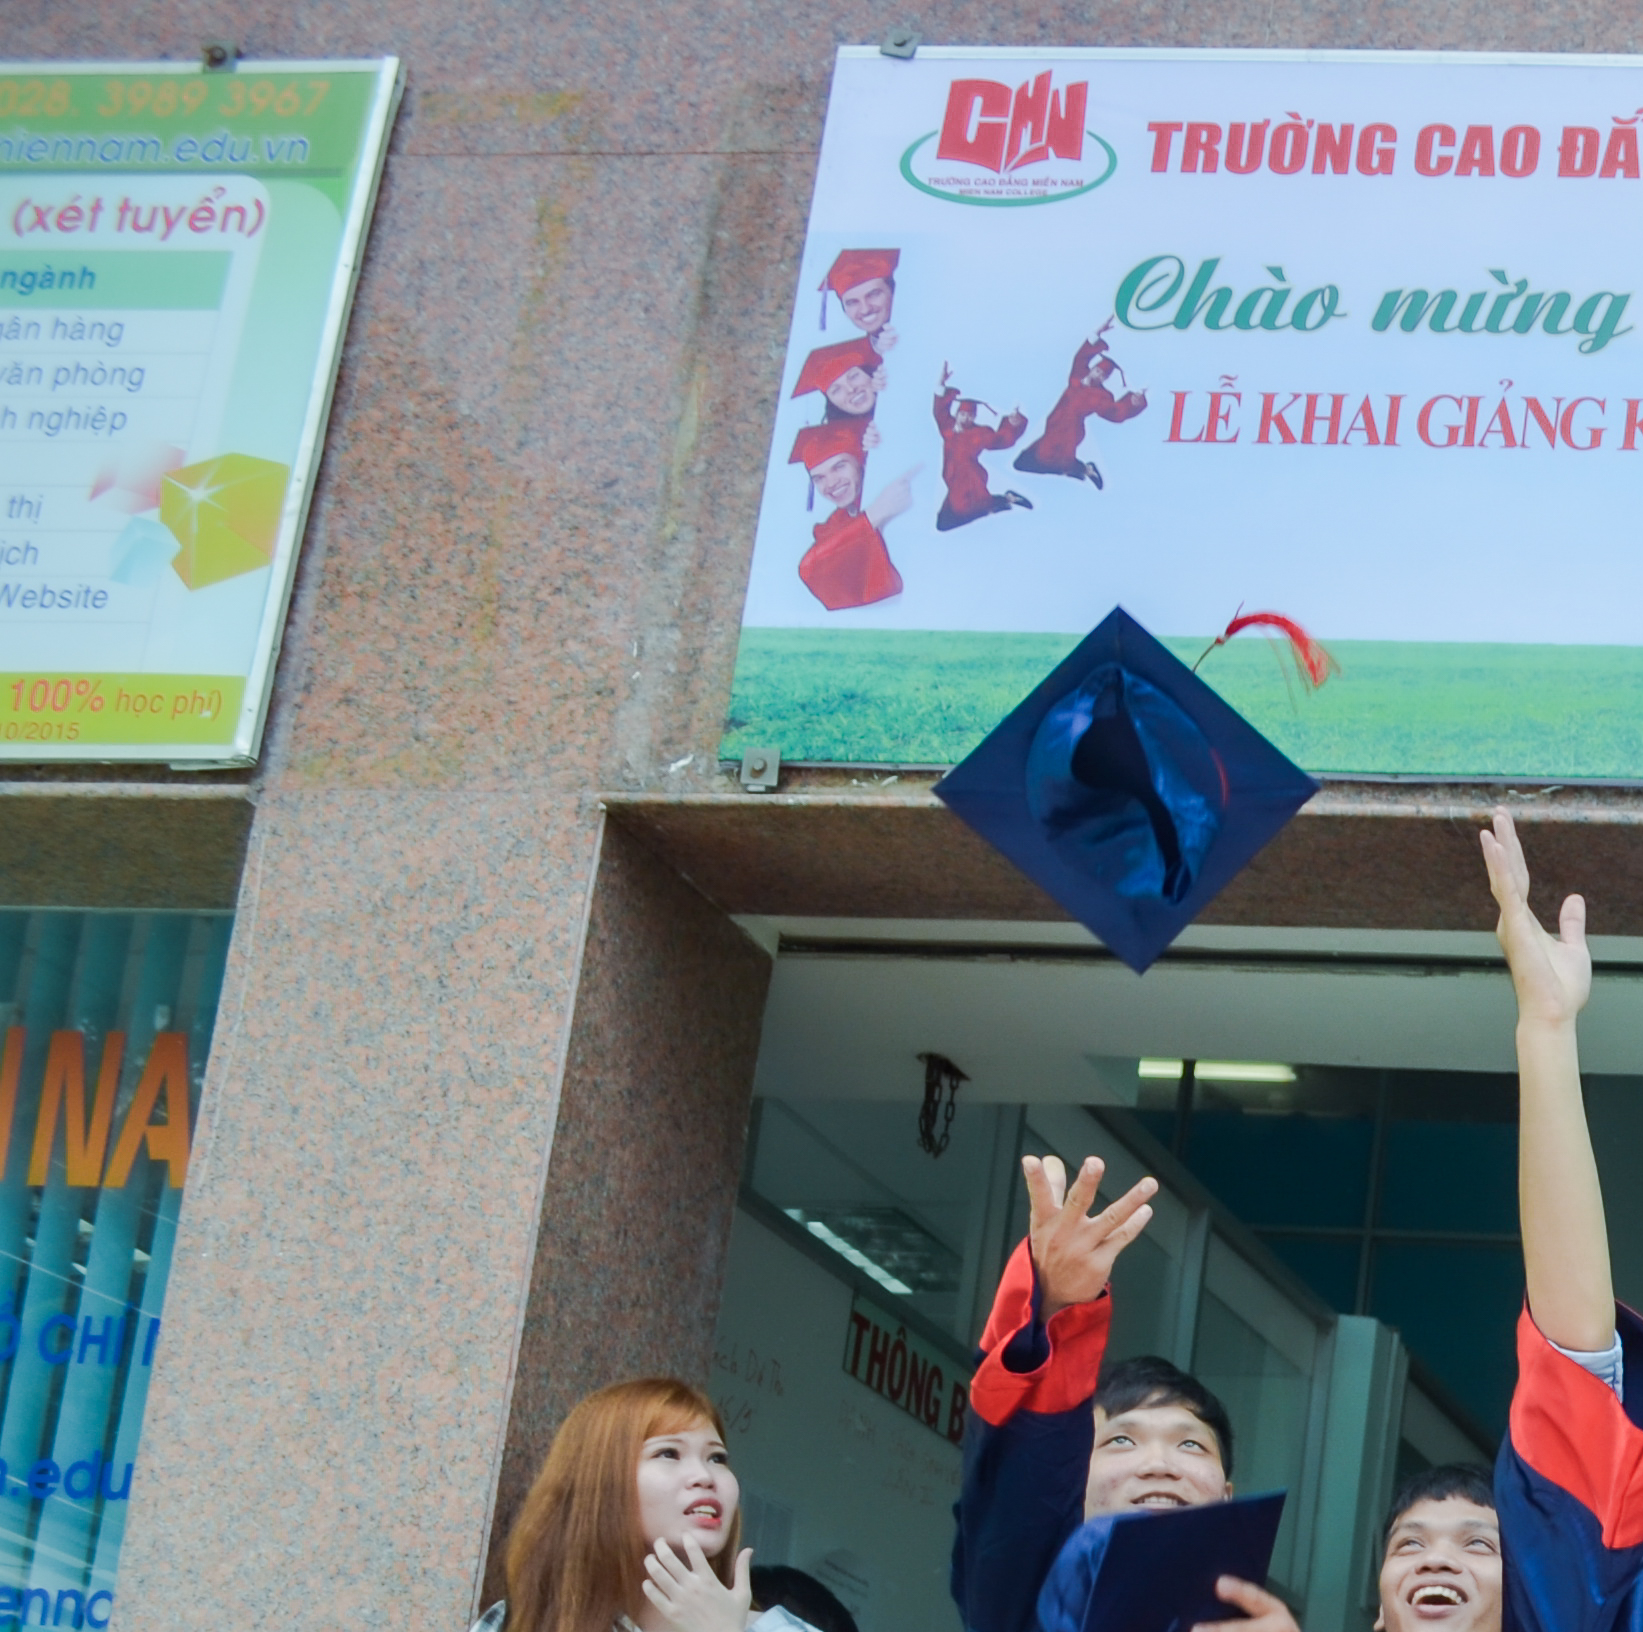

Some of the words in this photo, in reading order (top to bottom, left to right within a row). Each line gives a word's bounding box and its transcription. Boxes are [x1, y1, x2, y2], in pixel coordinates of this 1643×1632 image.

[97, 80, 208, 118] 3989
[218, 80, 331, 118] 3967
[1147, 111, 1398, 177] TRƯỜNG
[1414, 122, 1541, 178] CAO
[974, 177, 996, 187] CAO
[13, 194, 104, 238] (xét
[117, 186, 266, 241] tuyển)
[0, 265, 97, 296] ngành
[1112, 254, 1347, 334] Chào
[1370, 267, 1633, 354] mừng
[51, 314, 125, 347] hàng
[51, 360, 147, 393] phòng
[28, 405, 129, 437] nghiệp
[1164, 374, 1242, 445] LỄ
[1251, 391, 1406, 447] KHAI
[1416, 379, 1607, 451] GIẢNG
[8, 494, 43, 525] thị
[10, 679, 105, 713] 100%
[115, 688, 163, 720] học
[171, 689, 223, 723] phí)
[0, 721, 80, 741] 0/2015
[851, 1311, 944, 1431] THÔNG
